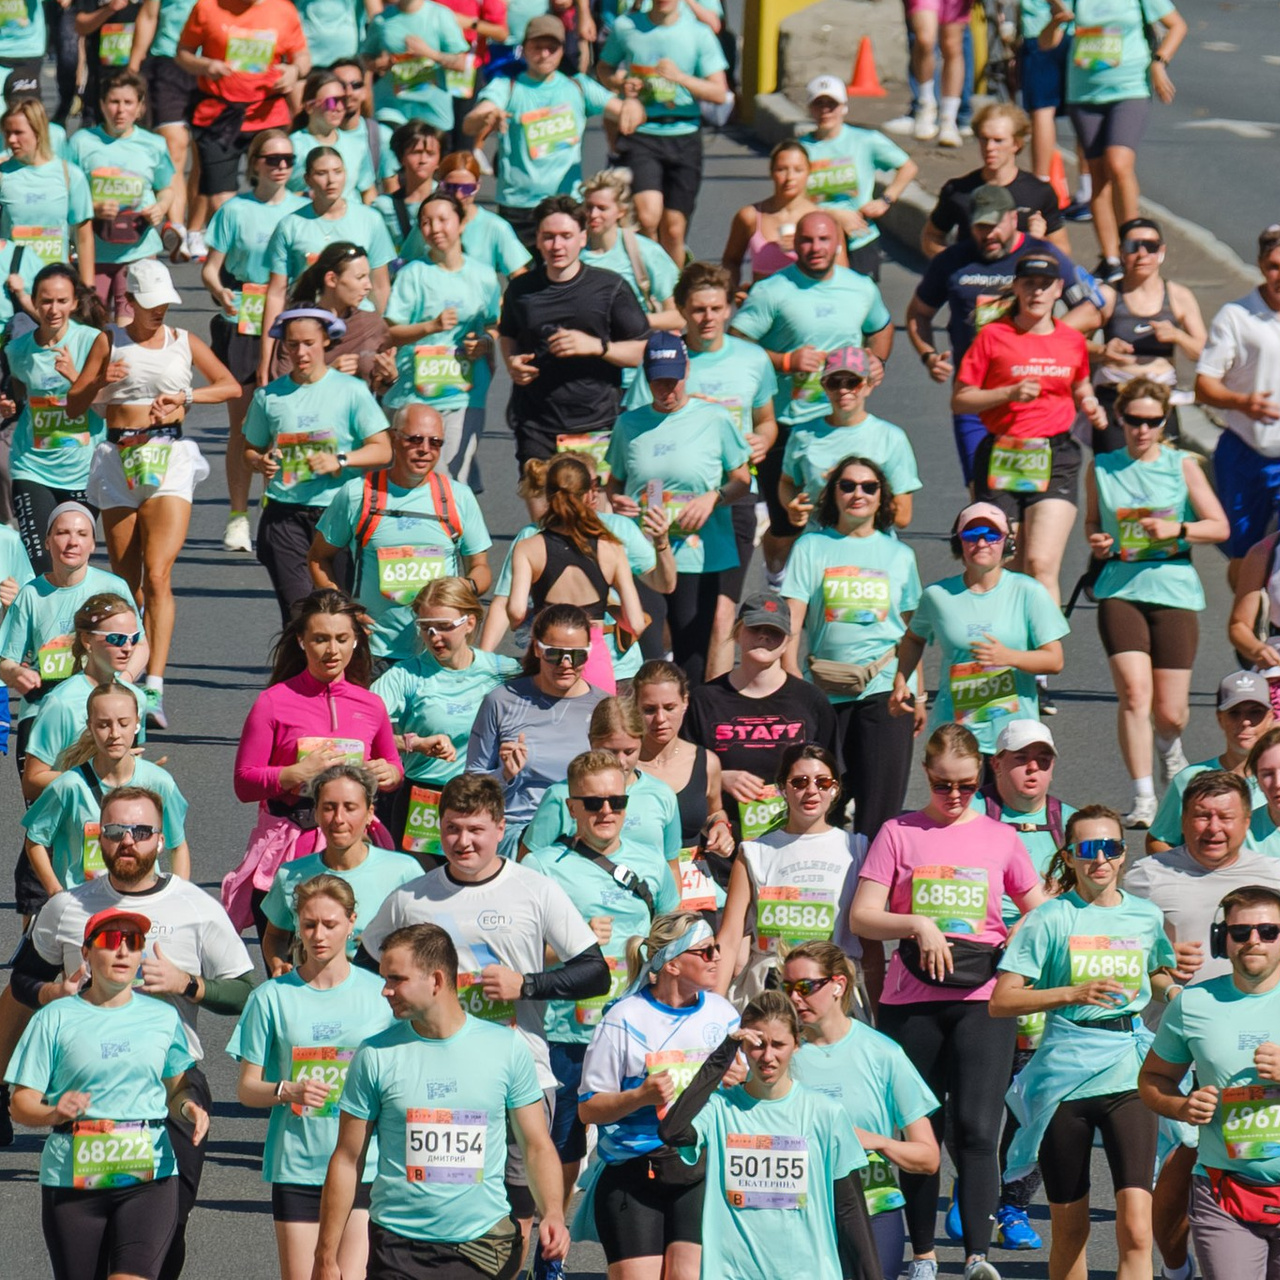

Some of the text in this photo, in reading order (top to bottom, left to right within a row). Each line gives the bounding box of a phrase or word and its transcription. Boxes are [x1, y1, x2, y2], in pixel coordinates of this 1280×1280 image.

[418, 359, 470, 377] 68709
[1011, 365, 1072, 378] SUNLIGHT
[124, 446, 169, 469] 65501
[992, 449, 1048, 469] 77230
[382, 562, 442, 581] 68267
[826, 579, 889, 600] 71383
[951, 672, 1013, 701] 77593
[716, 723, 802, 740] STAFF
[778, 860, 842, 878] WELLNESS
[793, 874, 825, 884] CLUB
[916, 883, 985, 908] 68535
[482, 915, 506, 925] ЕСП
[761, 904, 831, 929] 68586
[151, 925, 167, 935] СП
[1073, 955, 1141, 978] 76856
[77, 1137, 151, 1164] 68222
[410, 1130, 483, 1155] 50154
[426, 1154, 466, 1164] ДМИТРИЙ
[730, 1156, 804, 1180] 50155
[738, 1178, 797, 1190] ЕКАТЕРИНА
